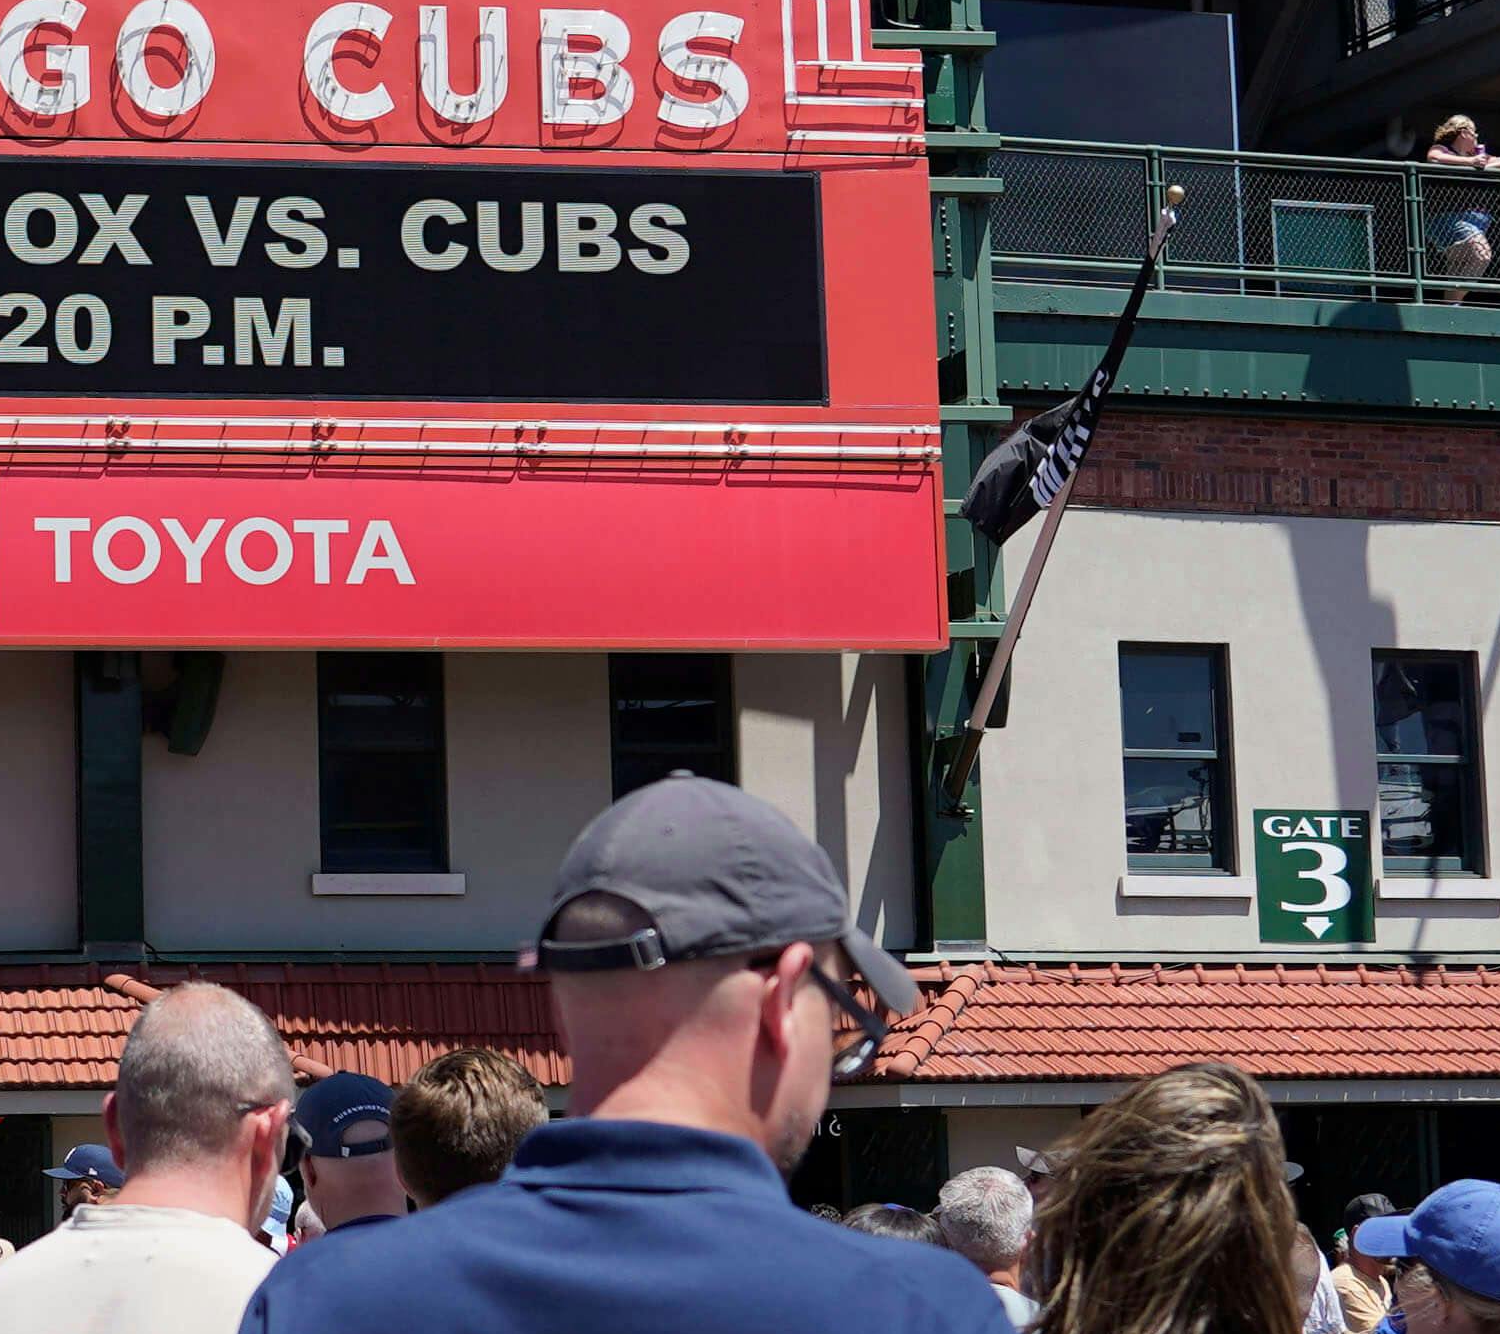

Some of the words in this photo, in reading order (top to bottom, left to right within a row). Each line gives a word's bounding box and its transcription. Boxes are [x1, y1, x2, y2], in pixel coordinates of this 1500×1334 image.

[303, 2, 750, 129] CUBS
[185, 195, 360, 269] VS.
[400, 198, 691, 275] CUBS
[152, 295, 345, 367] P.M.
[34, 515, 418, 586] TOYOTA
[1262, 816, 1363, 838] GATE
[1280, 841, 1352, 913] 3
